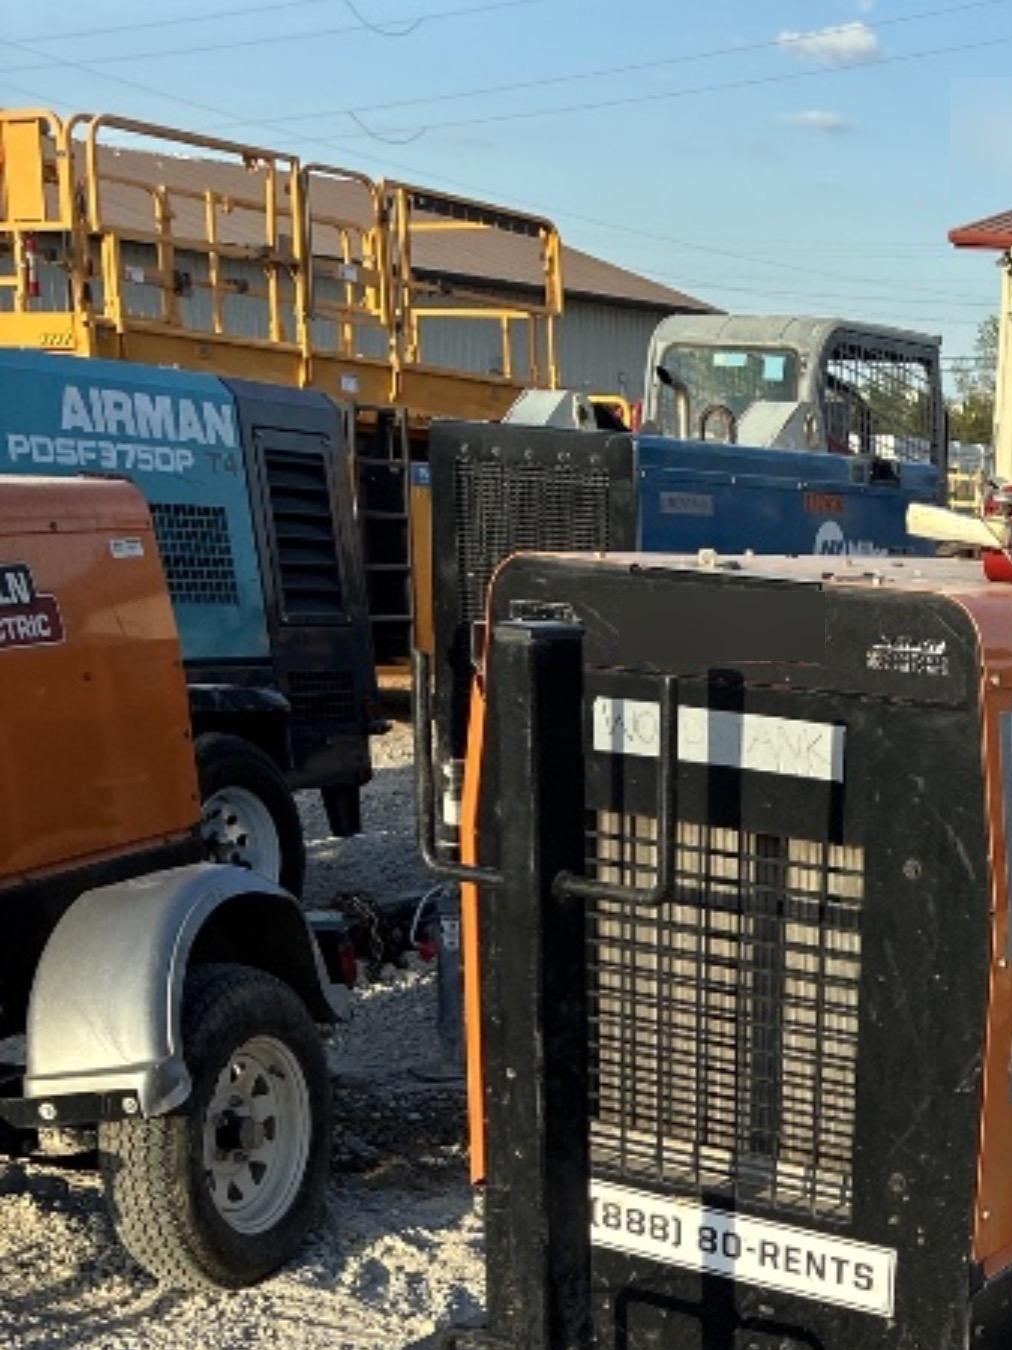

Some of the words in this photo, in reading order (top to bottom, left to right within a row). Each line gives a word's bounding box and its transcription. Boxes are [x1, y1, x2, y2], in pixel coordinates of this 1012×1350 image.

[61, 384, 236, 447] AIRMAN
[592, 1197, 682, 1247] (888)
[698, 1226, 875, 1291] 80-RENTS
